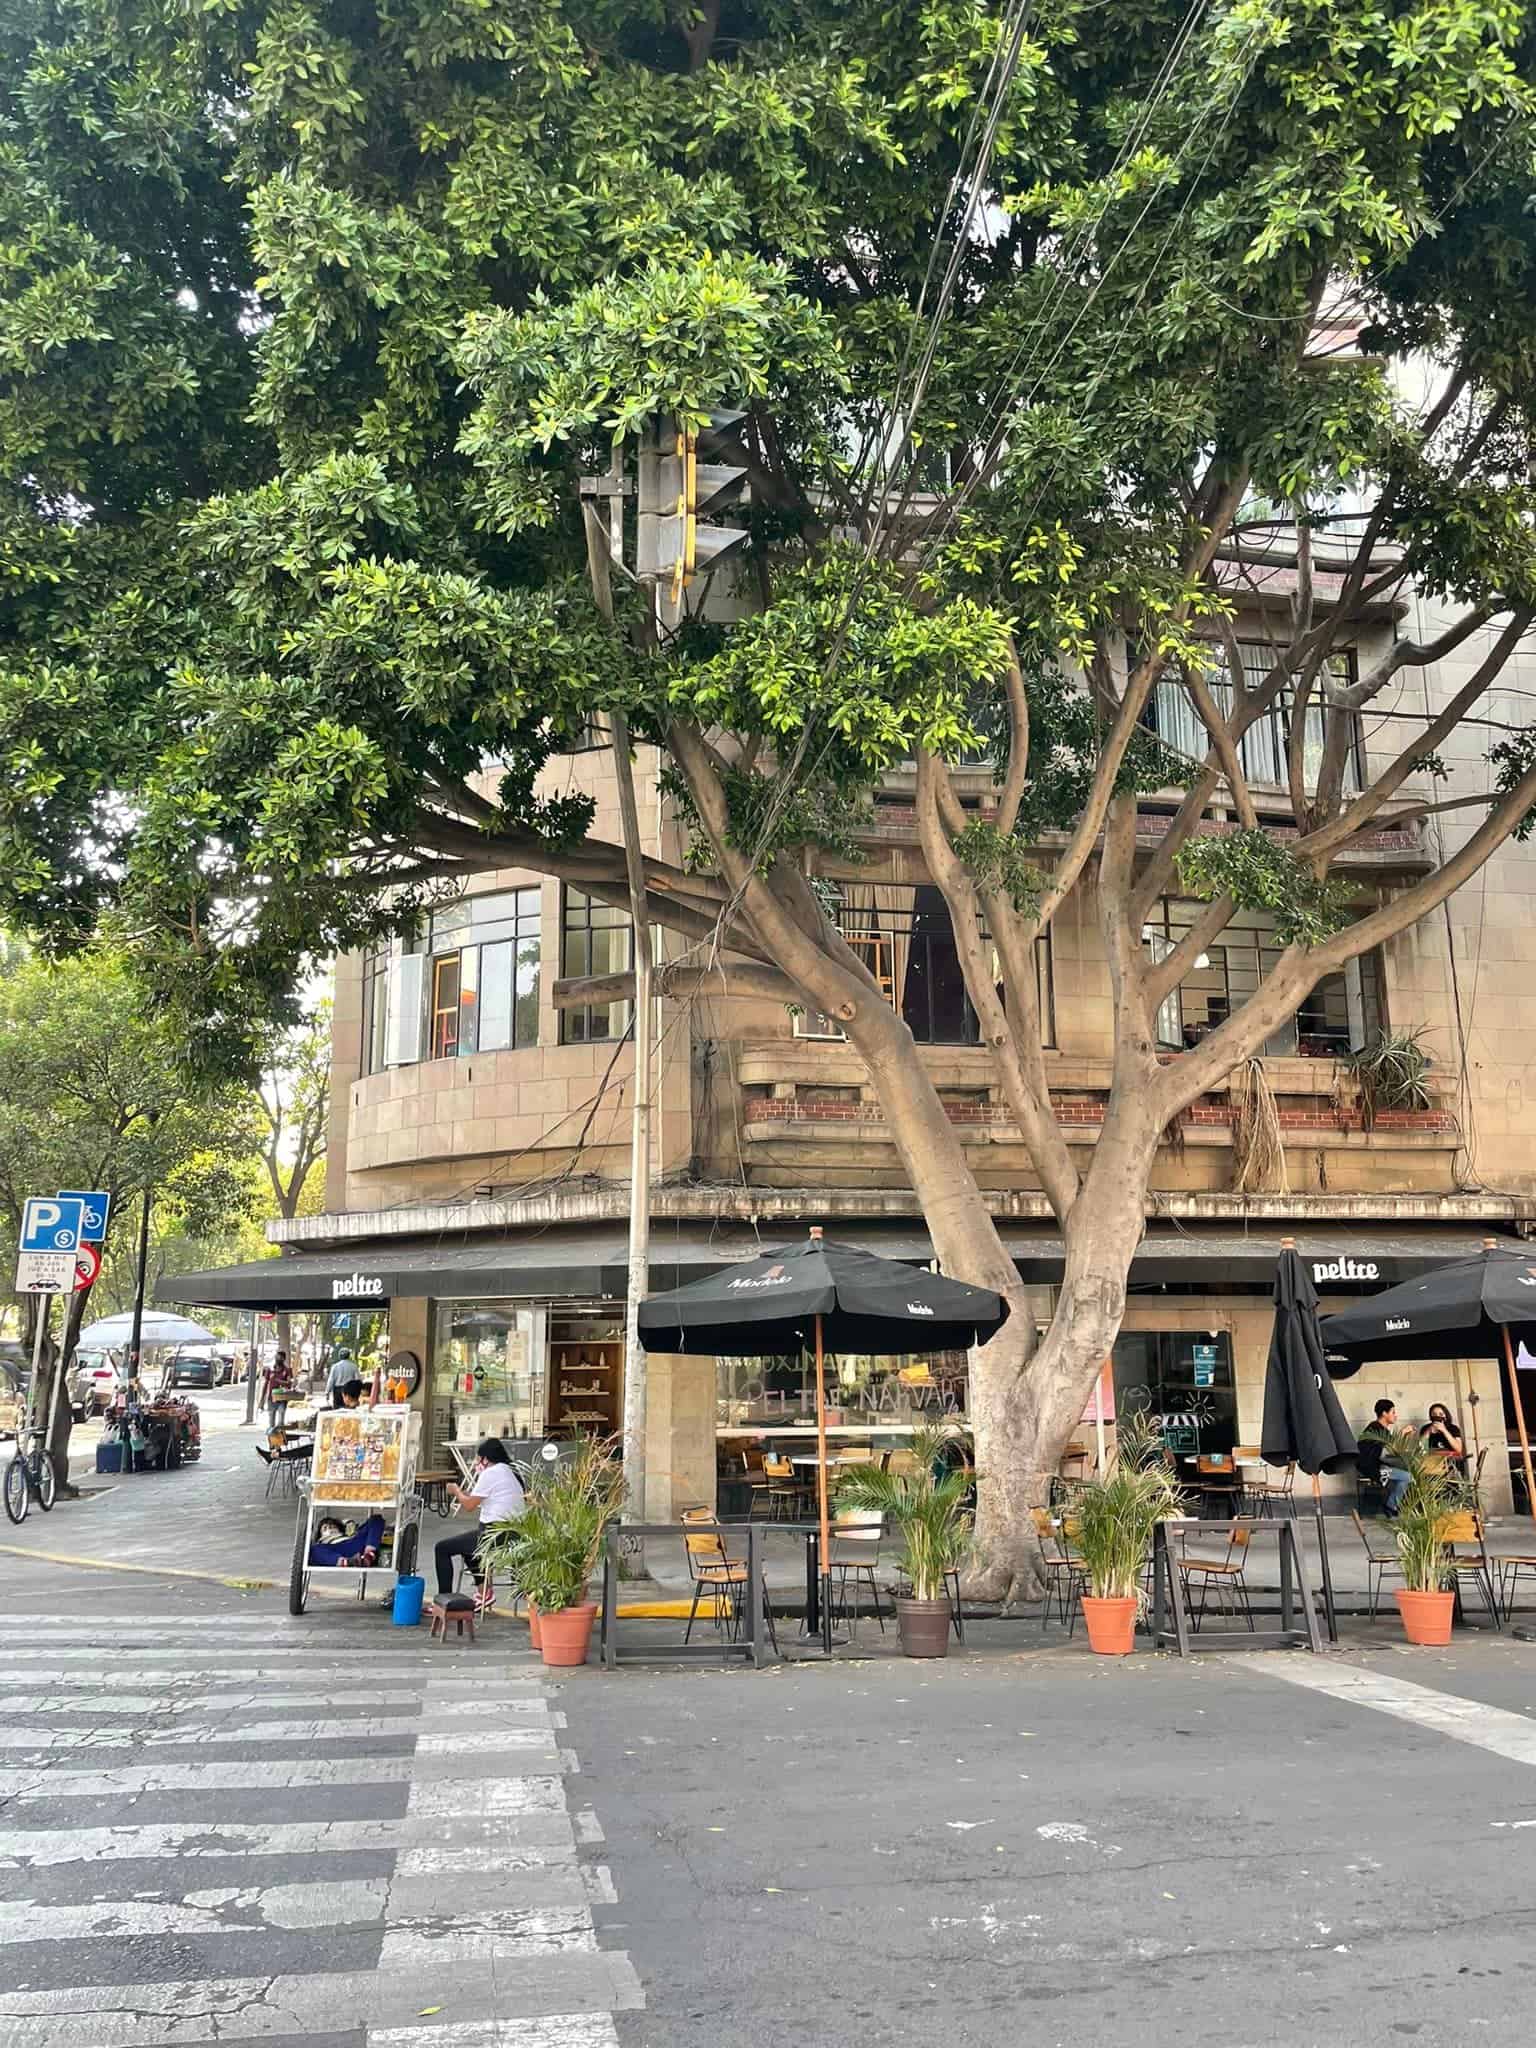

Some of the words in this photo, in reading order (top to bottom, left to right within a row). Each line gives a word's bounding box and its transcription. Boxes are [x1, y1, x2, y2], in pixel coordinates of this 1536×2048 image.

[26, 1202, 62, 1240] P
[1312, 1256, 1380, 1283] peltre
[333, 1272, 383, 1300] peltre
[1385, 1317, 1410, 1332] Modelo
